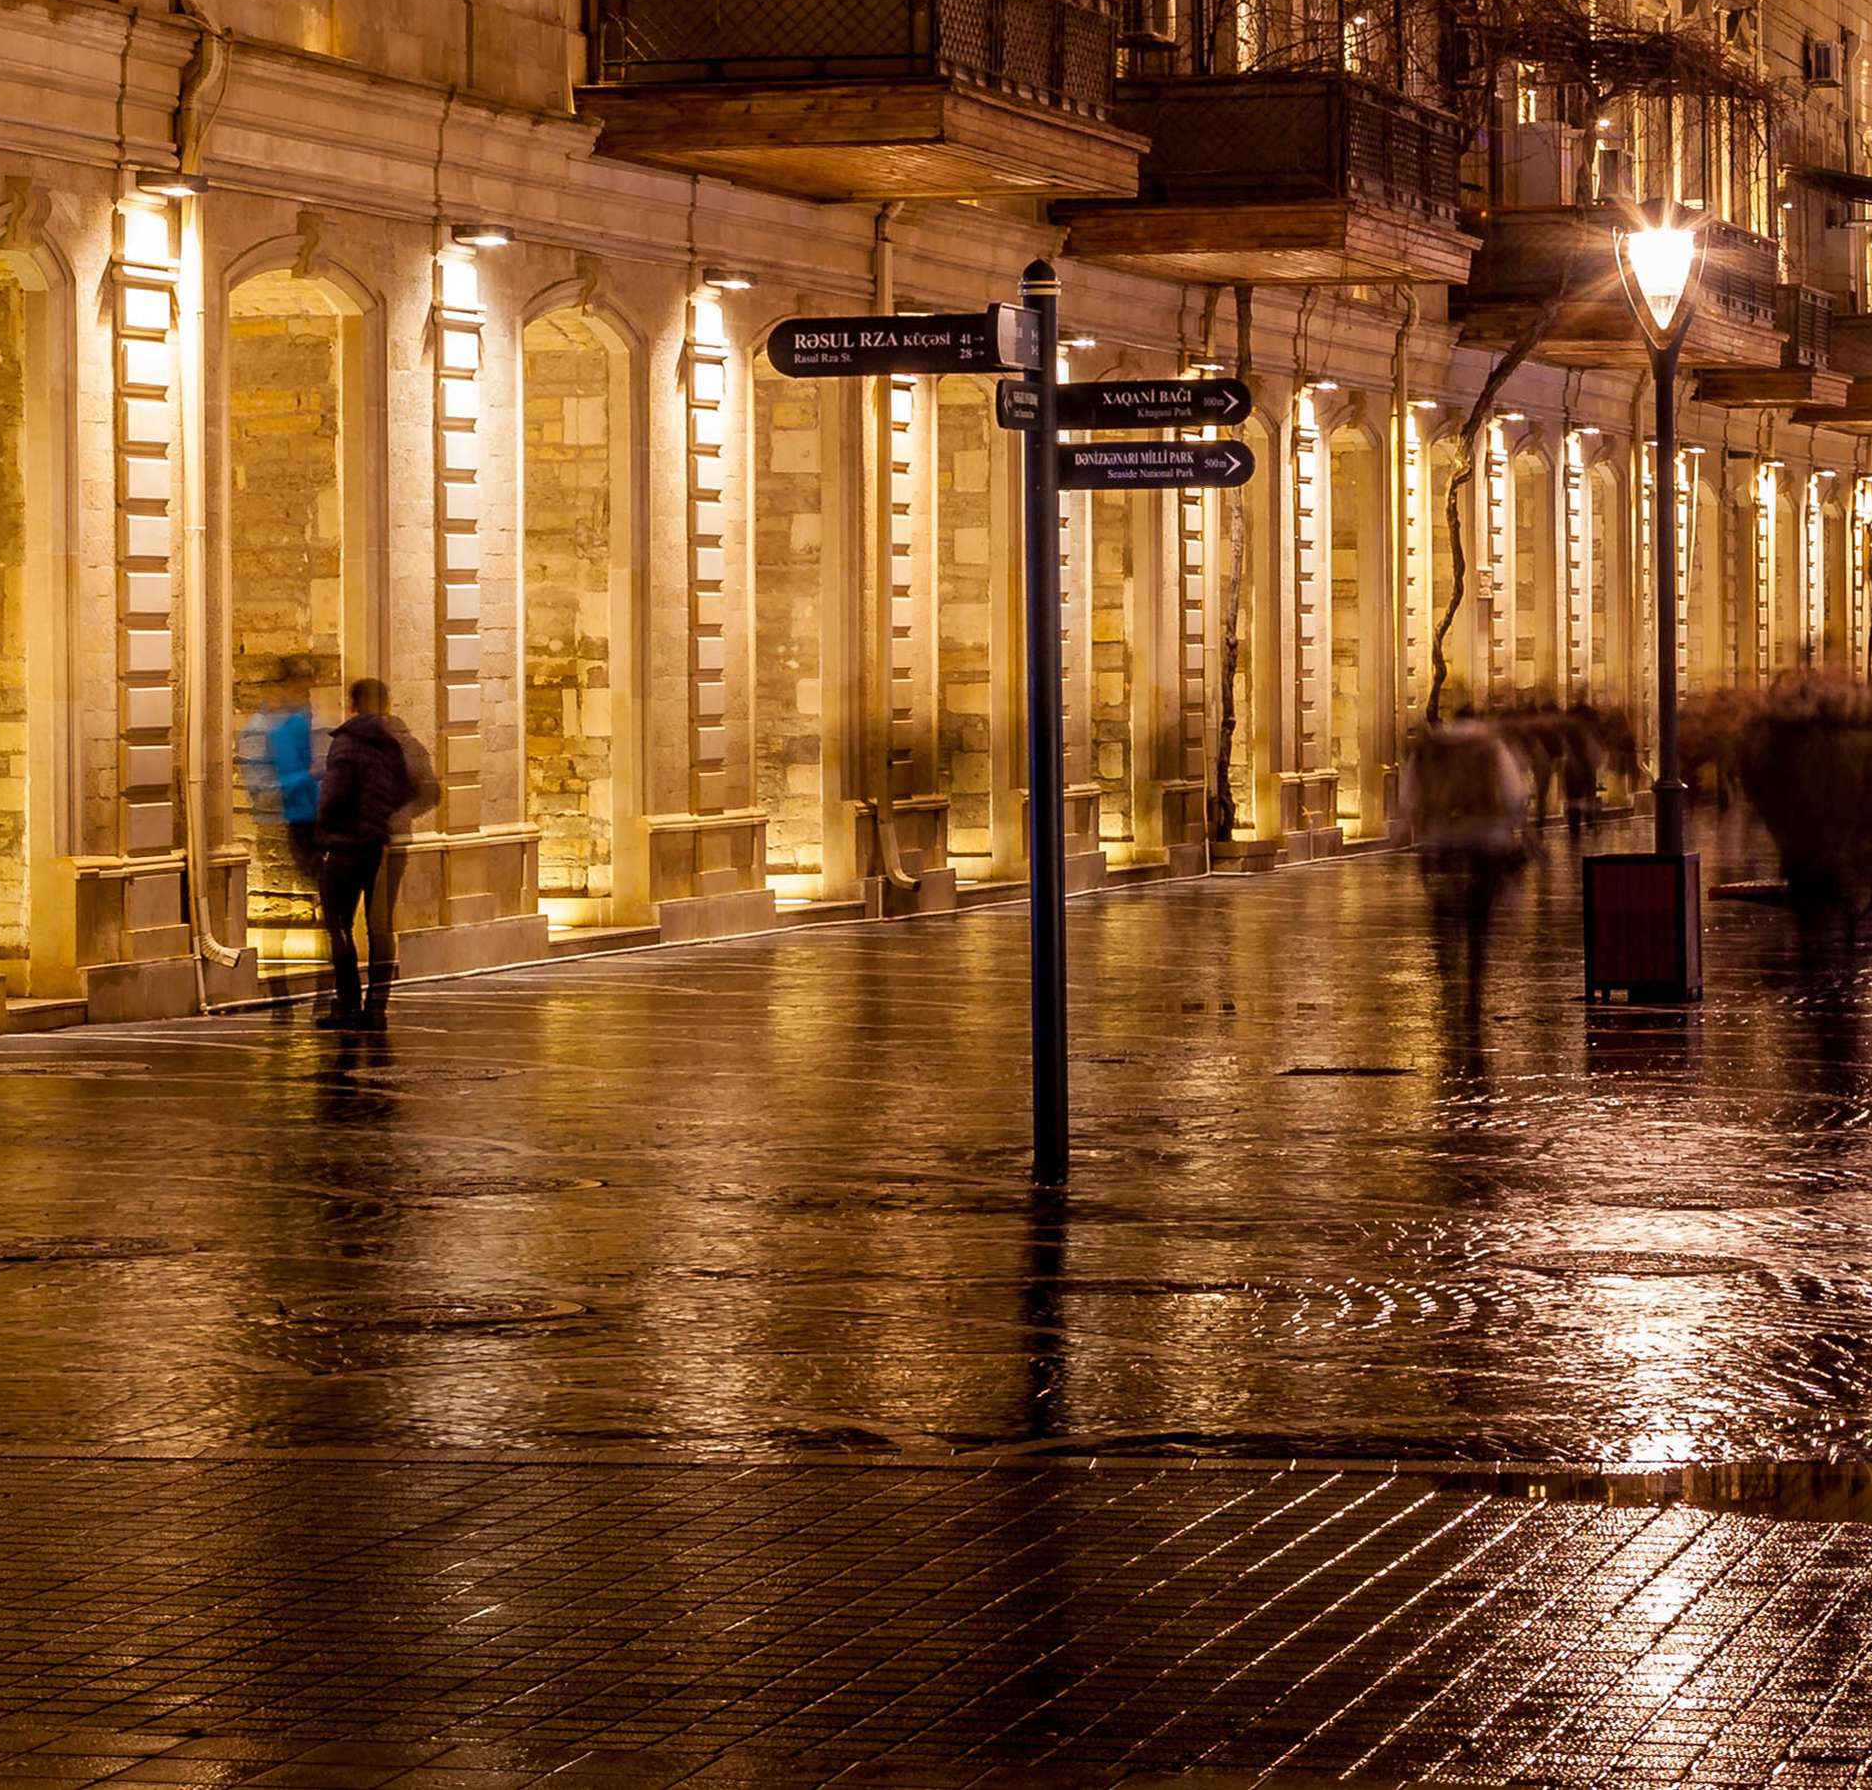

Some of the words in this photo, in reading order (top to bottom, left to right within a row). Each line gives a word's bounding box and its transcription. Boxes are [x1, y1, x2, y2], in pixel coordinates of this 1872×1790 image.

[794, 332, 856, 349] RƏSUL
[859, 331, 898, 347] RZA
[959, 333, 972, 345] 41
[794, 353, 819, 363] Rasul
[821, 353, 840, 363] Rza
[959, 348, 973, 359] 28
[1102, 389, 1156, 407] XAQANİ
[1159, 387, 1192, 404] BAĞI
[1203, 396, 1225, 407] 100m
[1173, 407, 1193, 417] Park
[1140, 449, 1168, 465] MİLLİ
[1169, 451, 1195, 464] PARK
[1204, 458, 1228, 469] 500m
[1107, 468, 1138, 479] Seaside
[1139, 467, 1174, 478] National
[1176, 467, 1194, 478] Park
